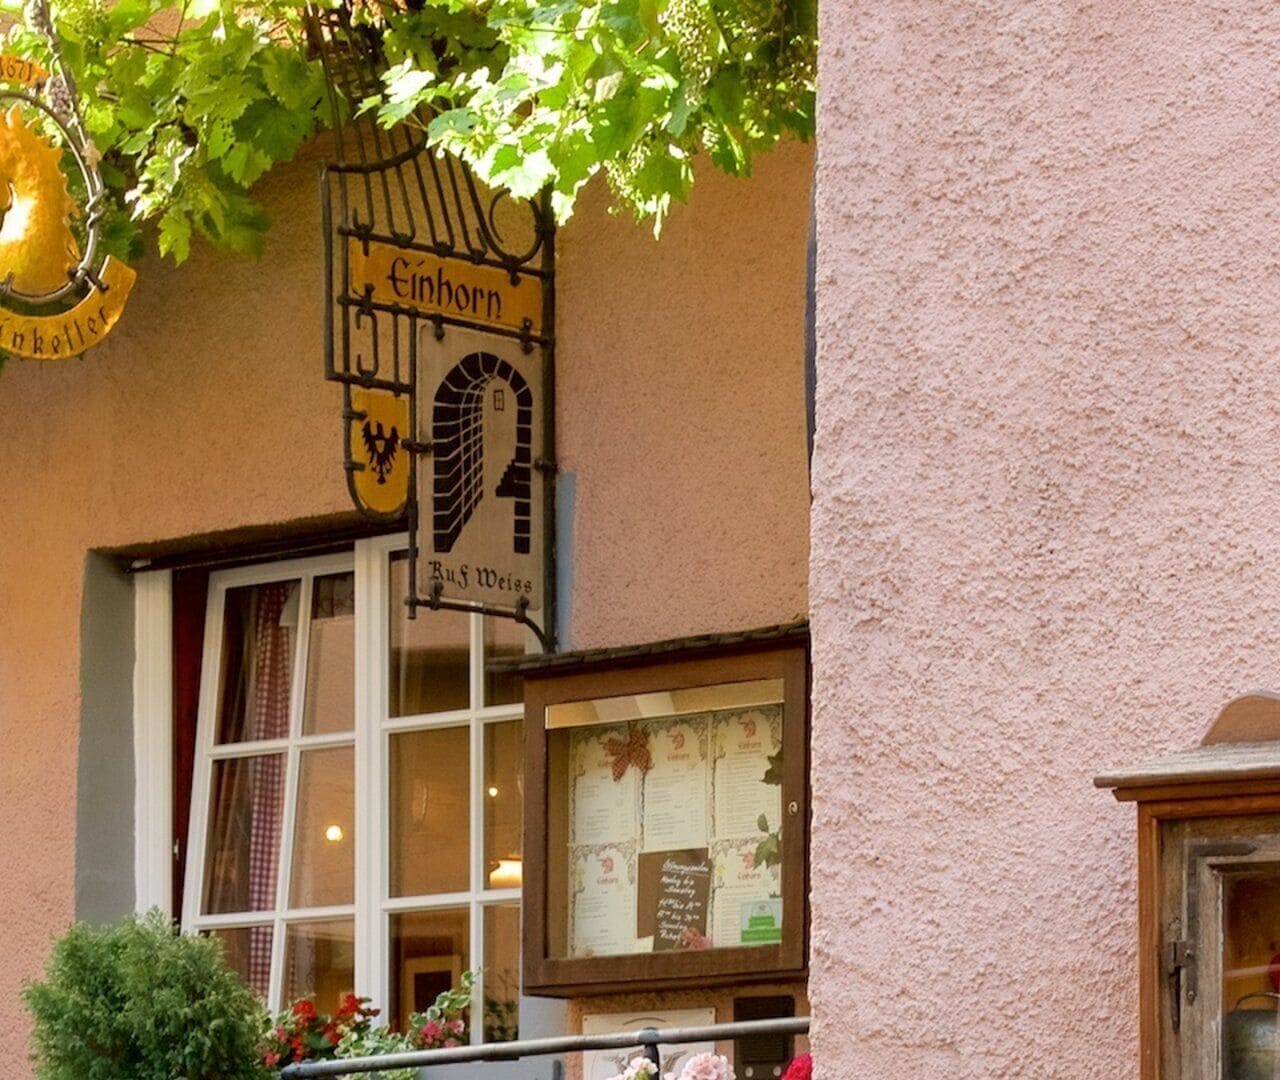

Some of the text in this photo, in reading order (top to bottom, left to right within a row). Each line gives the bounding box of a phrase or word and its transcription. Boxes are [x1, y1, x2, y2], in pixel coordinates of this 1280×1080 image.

[386, 257, 501, 319] Einhorn
[428, 560, 533, 593] Ruf Weiss
